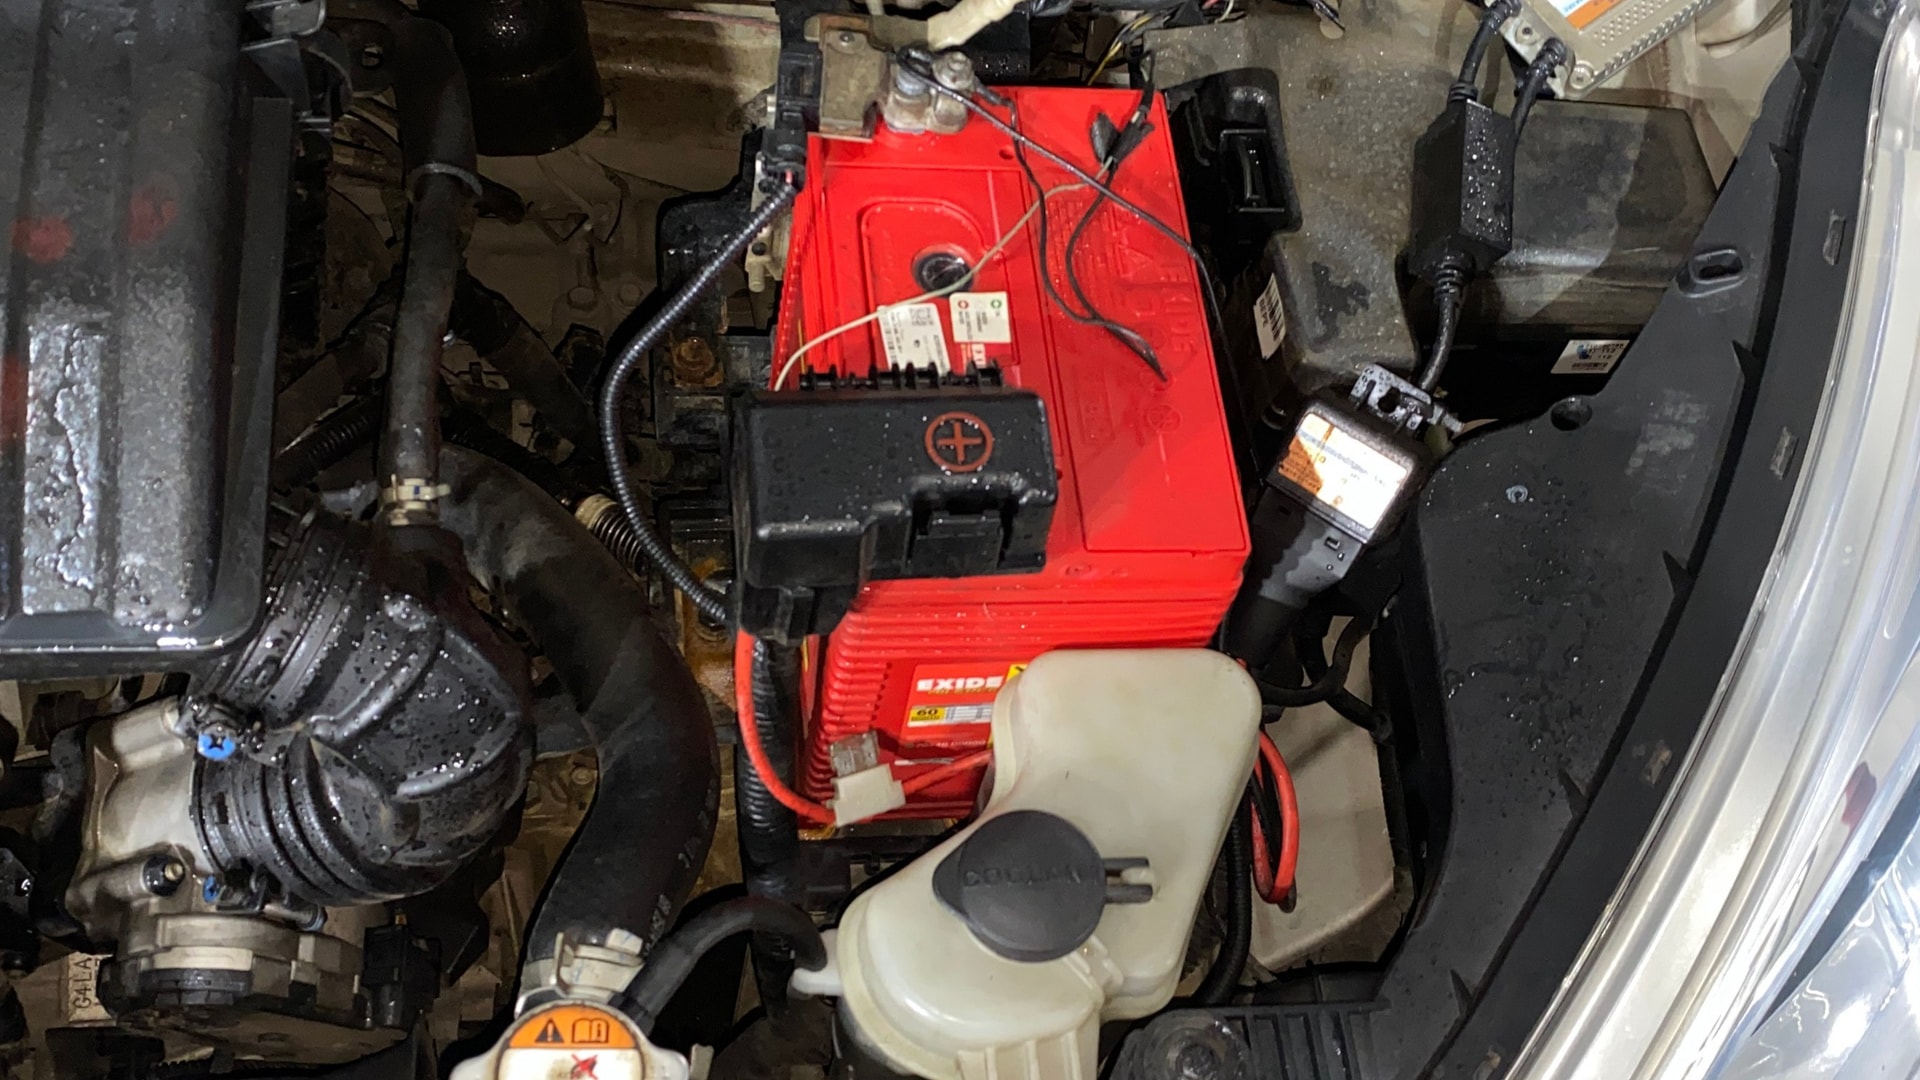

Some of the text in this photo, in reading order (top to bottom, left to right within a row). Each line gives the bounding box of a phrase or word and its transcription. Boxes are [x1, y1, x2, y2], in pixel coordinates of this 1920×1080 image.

[916, 676, 1004, 692] EXIDE
[917, 708, 938, 716] 60
[74, 957, 92, 1008] G4LA
